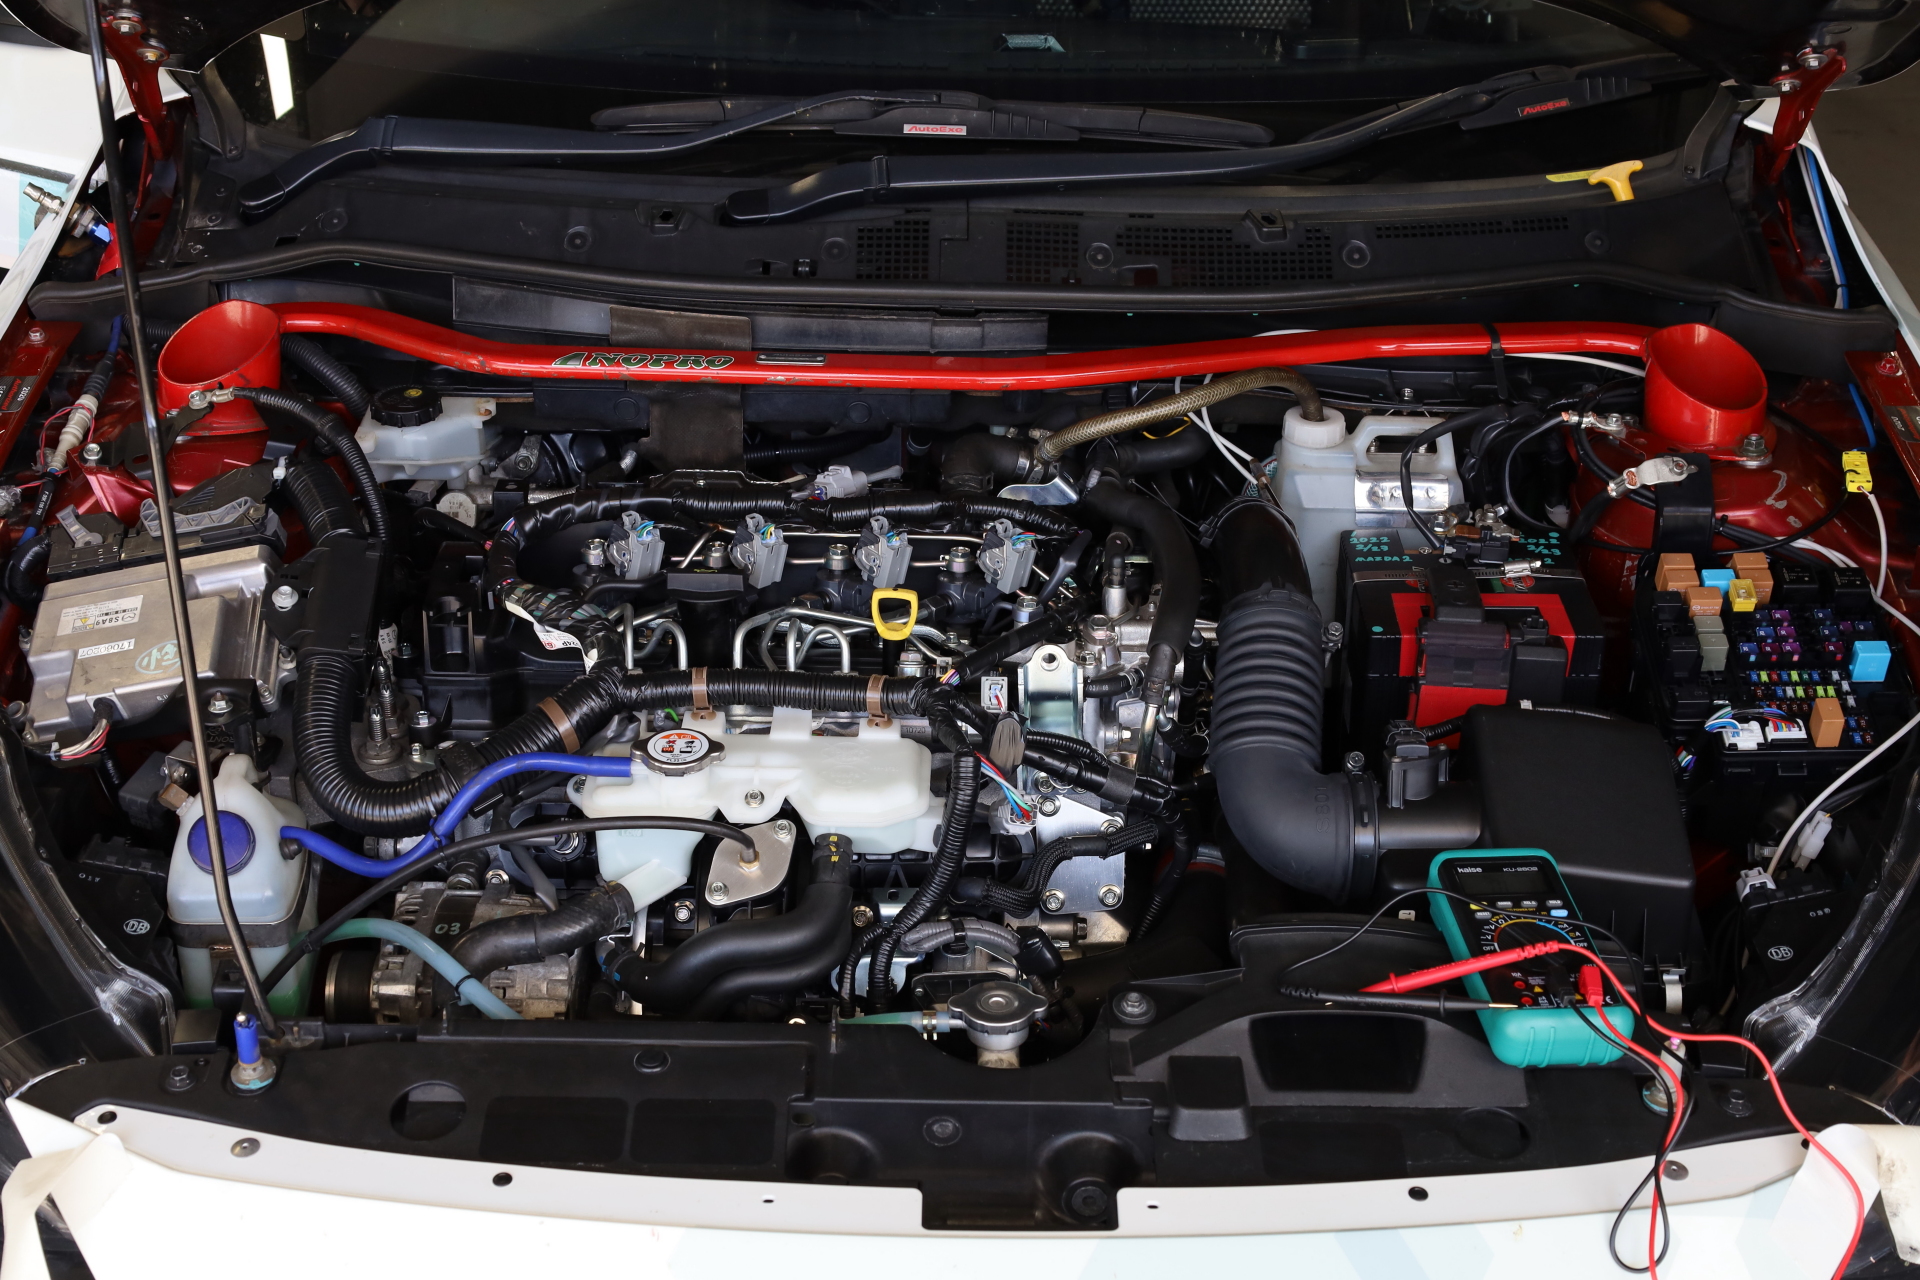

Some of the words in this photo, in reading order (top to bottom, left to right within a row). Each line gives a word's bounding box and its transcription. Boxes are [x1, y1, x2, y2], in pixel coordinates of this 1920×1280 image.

[1523, 100, 1567, 115] AutoExe
[907, 125, 963, 133] AutoExe
[1350, 536, 1390, 544] 2022
[1355, 544, 1389, 552] 2/23
[1526, 544, 1561, 555] 2/23
[95, 616, 120, 626] S8A9
[80, 641, 132, 658] 17060207
[434, 922, 460, 935] 03
[1771, 947, 1791, 959] DB
